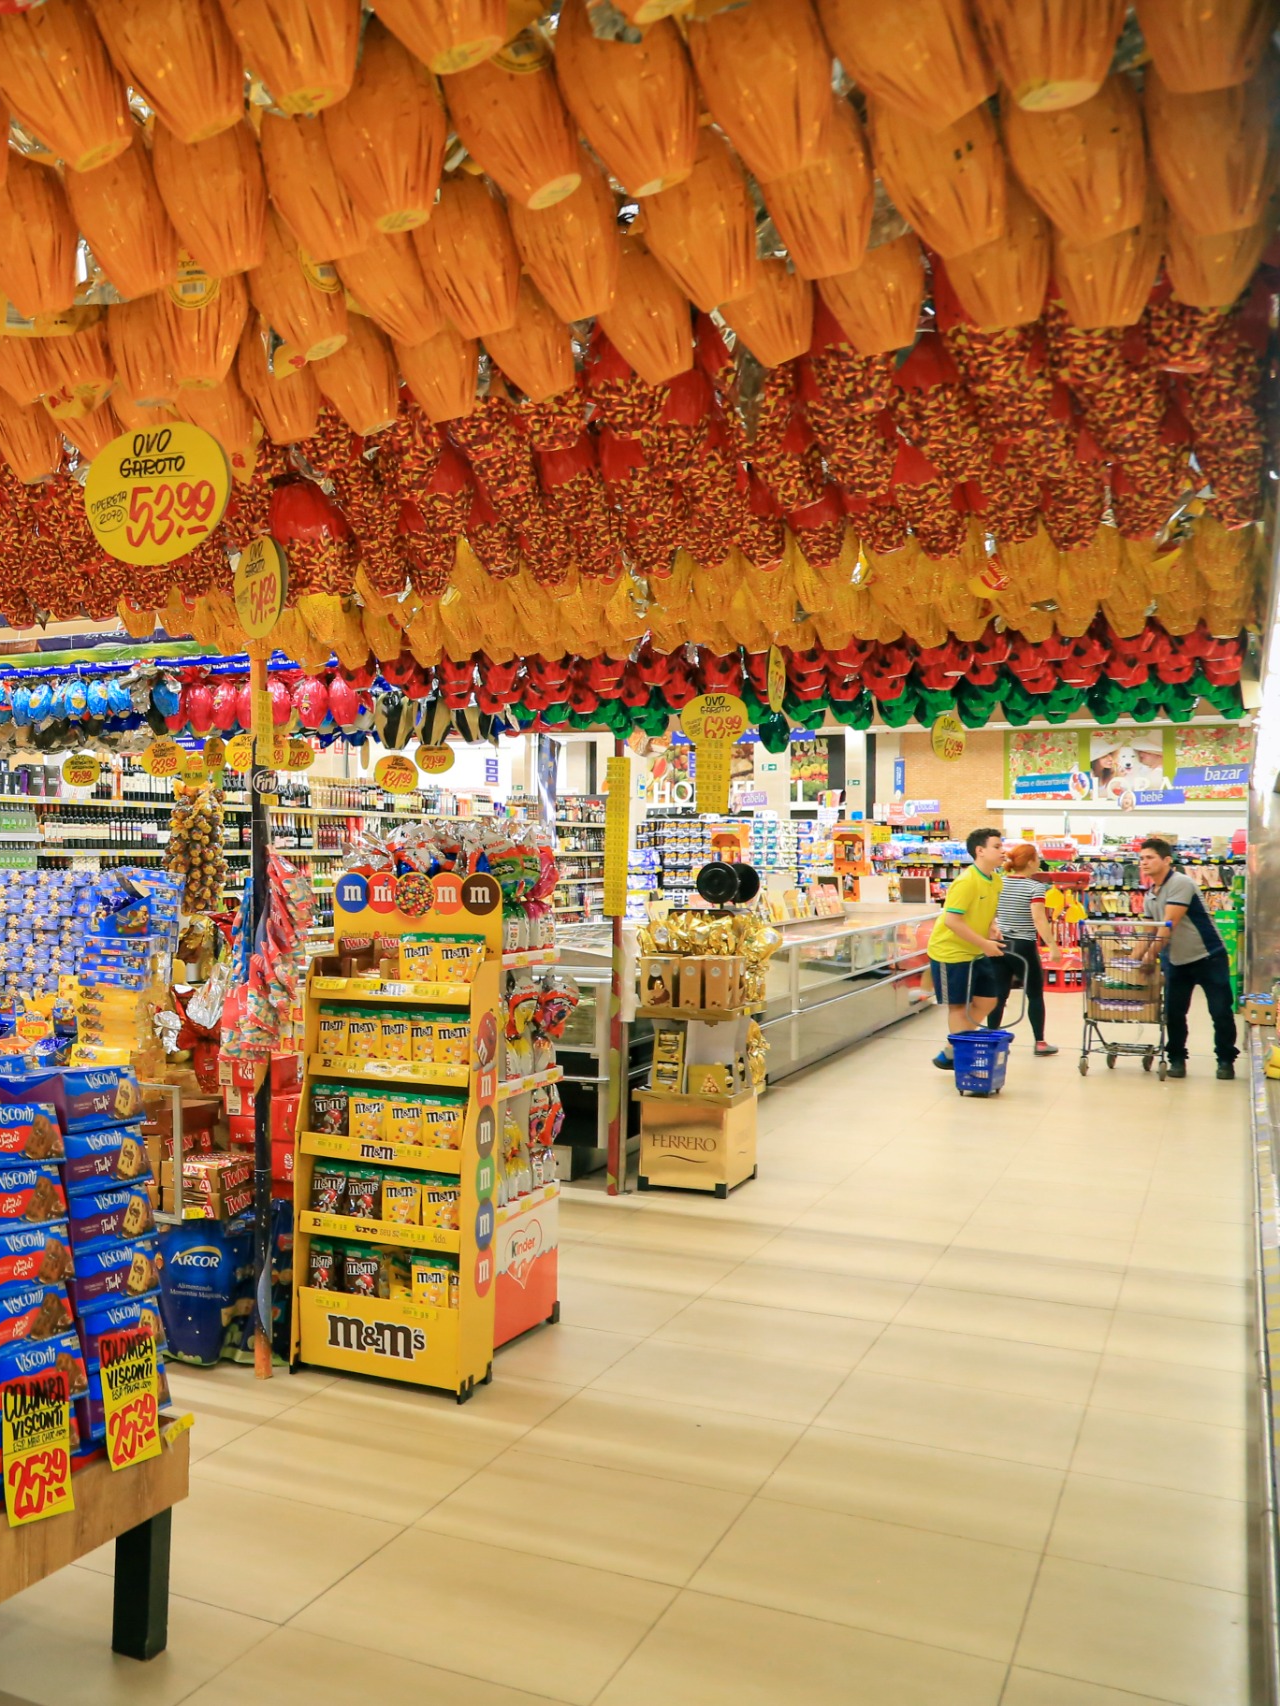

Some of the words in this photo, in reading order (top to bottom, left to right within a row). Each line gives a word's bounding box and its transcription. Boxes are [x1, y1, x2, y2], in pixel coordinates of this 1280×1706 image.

[133, 429, 171, 457] OVO
[120, 456, 185, 478] GAROTO
[90, 491, 127, 514] OPERETA
[701, 706, 731, 714] GAROTO
[705, 696, 725, 706] OVO
[257, 772, 276, 791] Fini
[1204, 767, 1243, 782] bazar
[1140, 790, 1164, 803] bebê
[344, 884, 362, 902] m
[374, 885, 392, 902] m
[437, 886, 456, 902] m
[471, 886, 490, 904] m
[341, 937, 370, 950] Twix
[85, 1071, 118, 1089] Visconti
[165, 1135, 193, 1158] Tix
[361, 1144, 397, 1160] m&m
[652, 1133, 716, 1152] FERRERO
[222, 1166, 250, 1191] Twix
[225, 1191, 252, 1215] Twix
[5, 1230, 45, 1252] Visconti
[171, 1251, 219, 1268] ARCOR
[15, 1346, 56, 1373] Visconti
[101, 1332, 153, 1368] COLOMBA
[106, 1358, 153, 1389] VISCONTI
[4, 1376, 66, 1422] COLOMBA
[12, 1405, 63, 1440] VISCONTI
